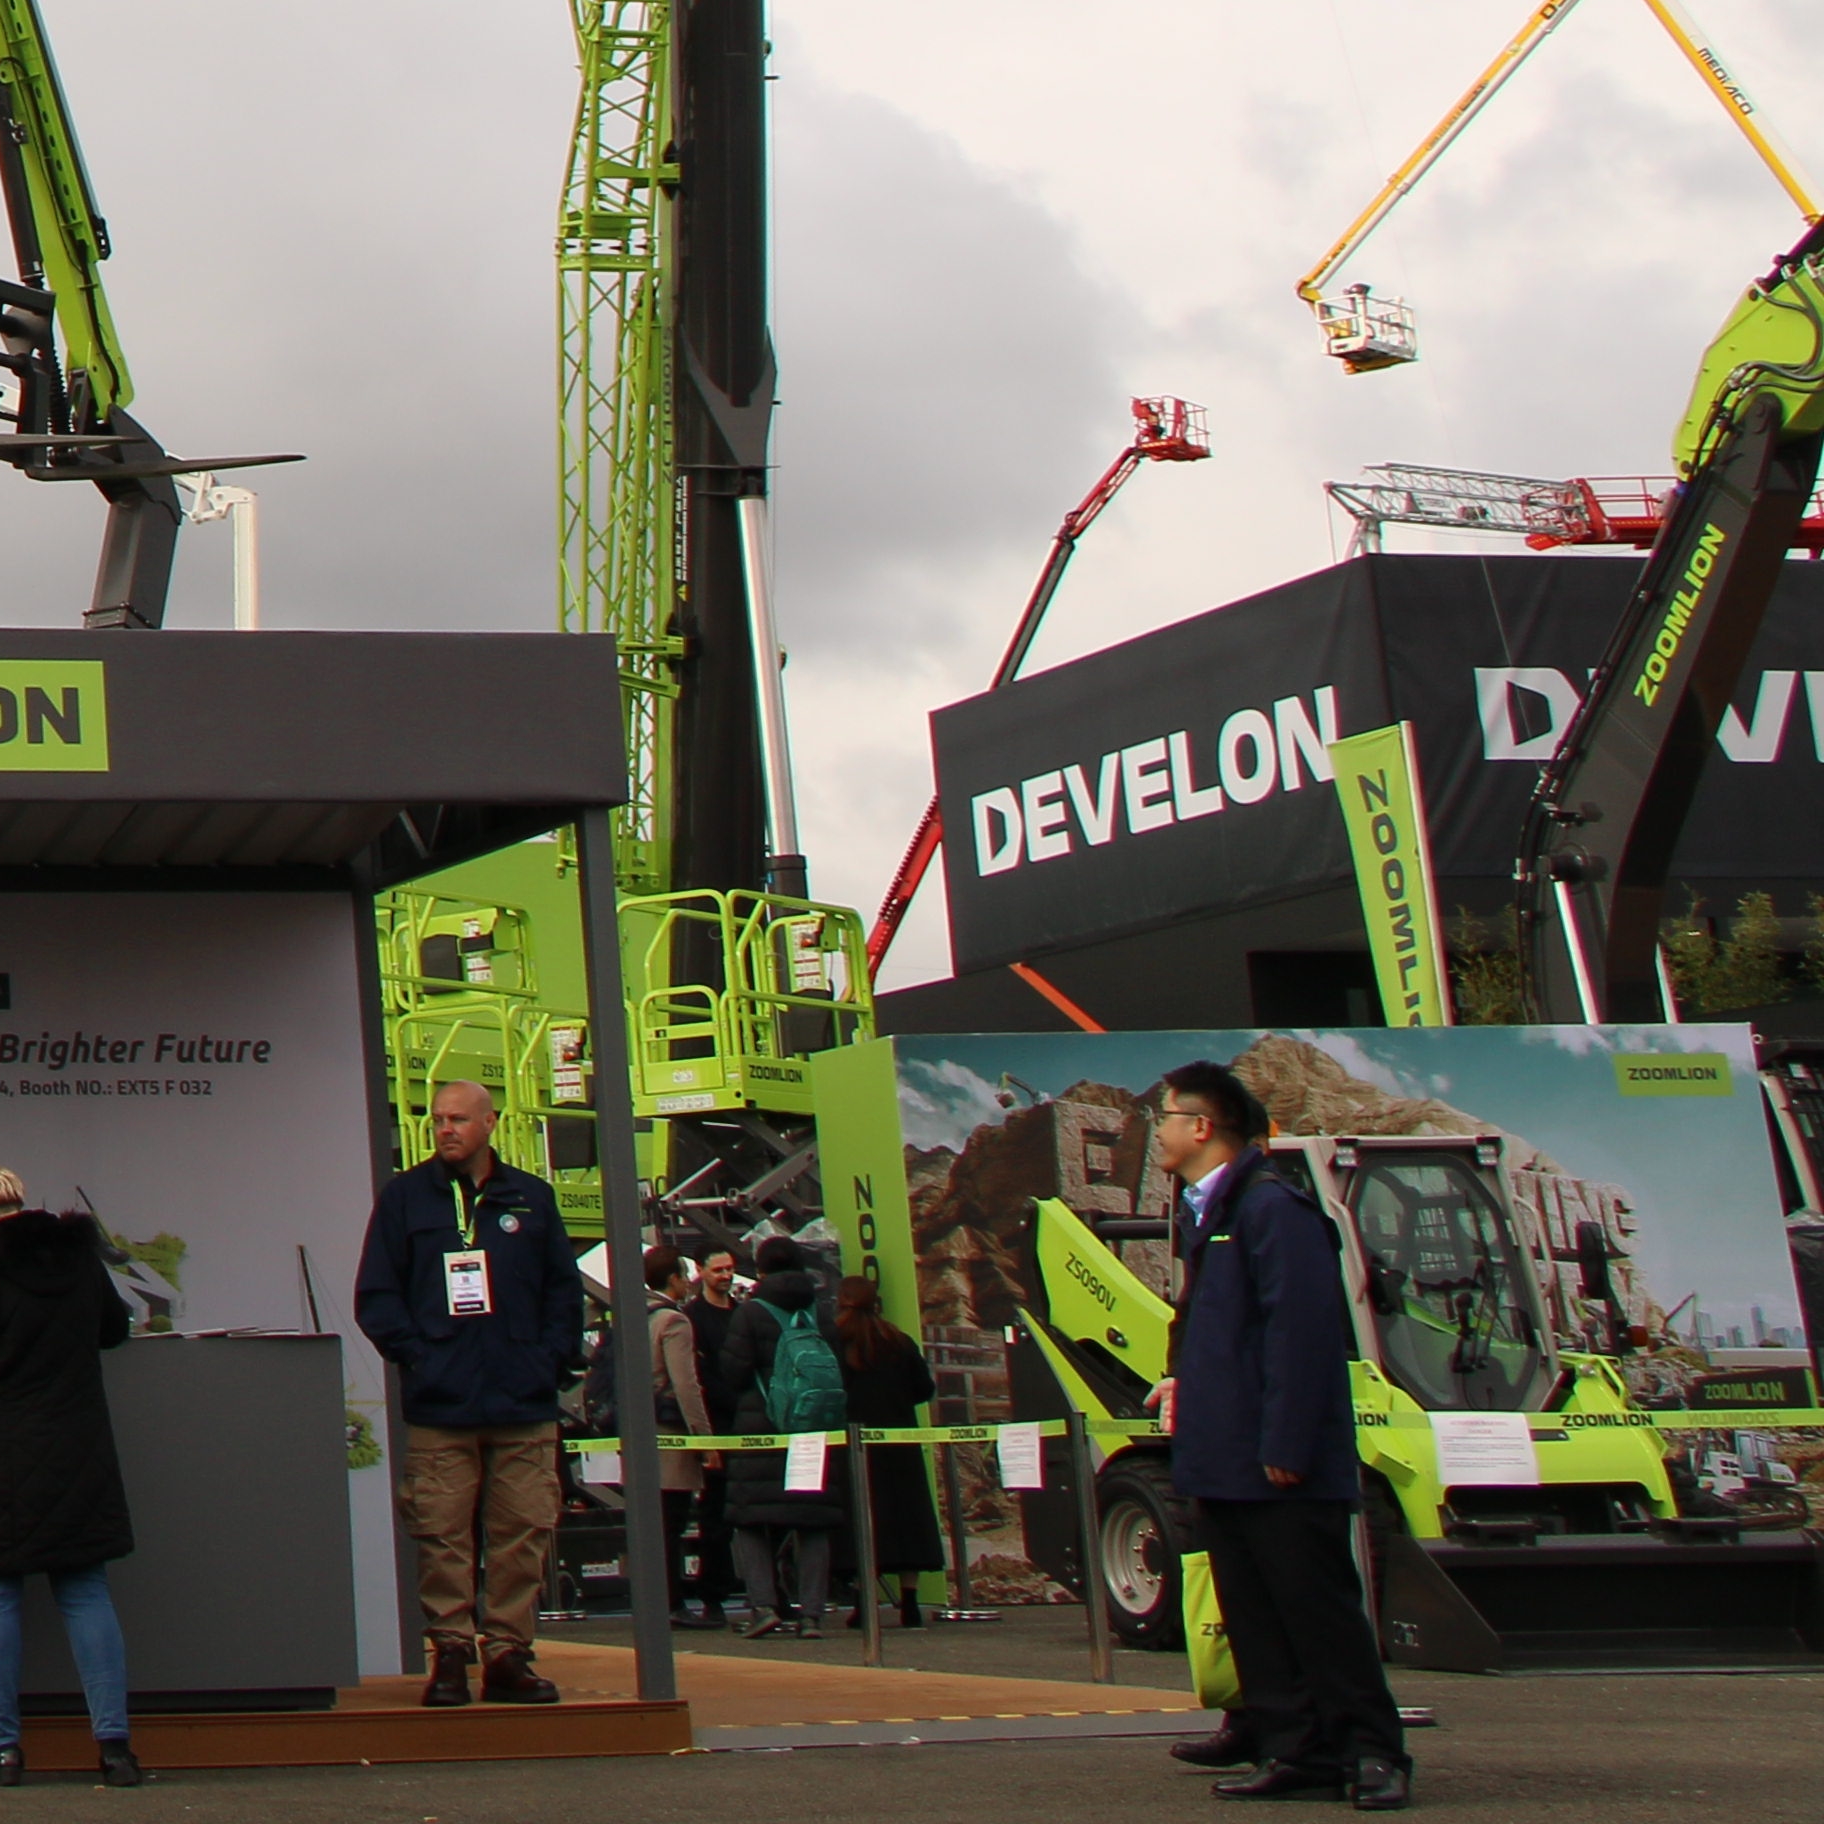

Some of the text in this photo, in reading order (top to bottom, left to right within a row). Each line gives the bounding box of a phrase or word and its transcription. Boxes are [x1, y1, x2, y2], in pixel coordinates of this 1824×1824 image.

[1633, 524, 1726, 707] ZOOMLION
[972, 685, 1340, 878] DEVELON
[1357, 768, 1423, 1027] ZOOMLI
[154, 1033, 272, 1064] Future
[748, 1064, 804, 1084] ZOOMLION
[1627, 1067, 1717, 1081] ZOOMLION
[21, 1078, 71, 1096] Booth
[76, 1080, 113, 1096] NO.:
[166, 1080, 176, 1096] F
[180, 1080, 213, 1096] 032
[1065, 1251, 1117, 1312] ZS090V
[1703, 1381, 1786, 1401] ZOOMLION
[1559, 1412, 1652, 1428] ZOOMLION
